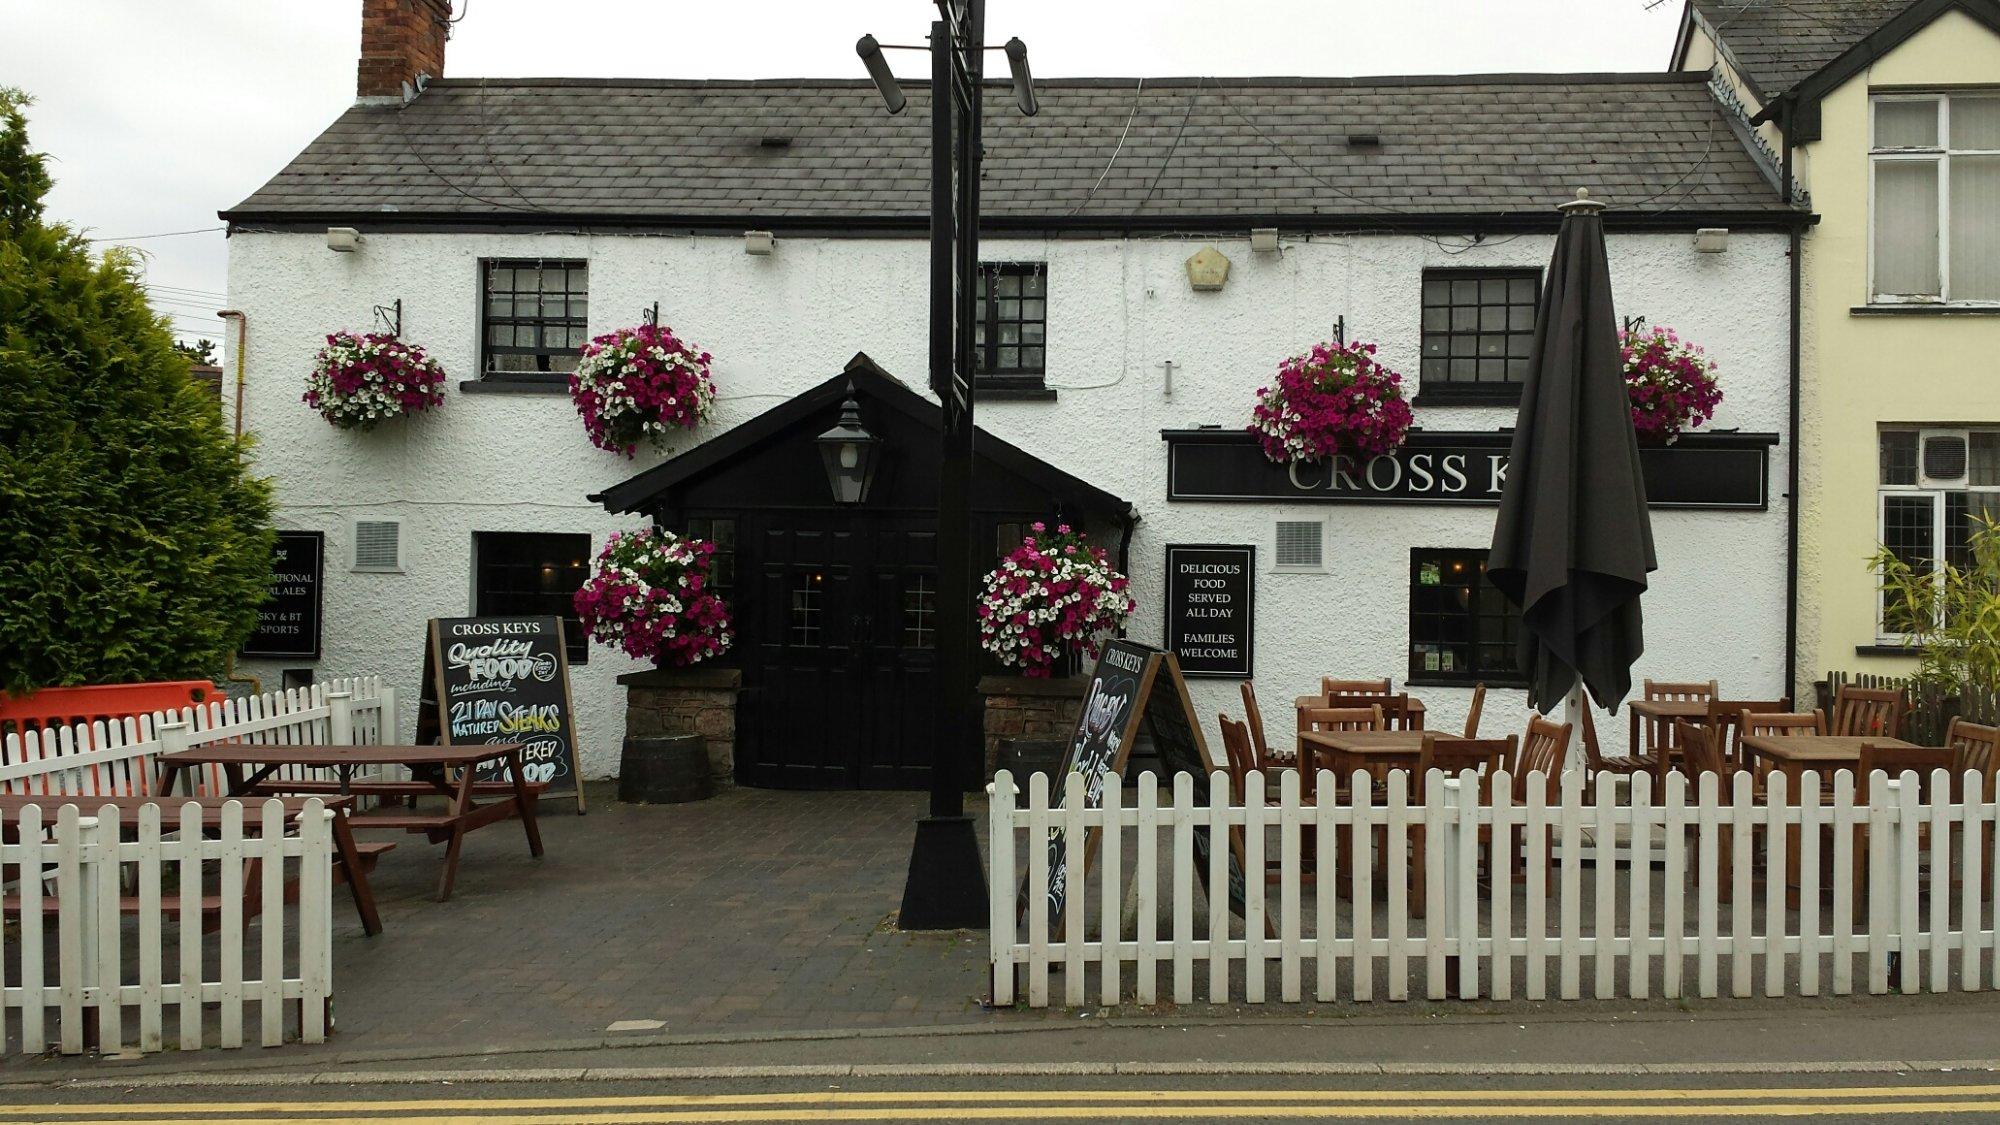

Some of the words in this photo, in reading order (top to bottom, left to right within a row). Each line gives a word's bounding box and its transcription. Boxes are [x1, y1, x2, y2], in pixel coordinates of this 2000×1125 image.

[1289, 454, 1467, 492] CROSS
[1180, 564, 1240, 574] DELICIOUS
[1194, 579, 1226, 588] FOOD
[282, 587, 307, 596] ALES
[1188, 593, 1231, 603] SERVED
[258, 613, 277, 621] SKY
[280, 613, 287, 621] &
[289, 613, 302, 621] BT
[1186, 608, 1207, 617] ALL
[1210, 608, 1233, 618] DAY
[260, 625, 299, 634] SPORTS
[452, 623, 500, 635] CROSS
[503, 622, 541, 634] KEYS
[1184, 634, 1235, 643] FAMILIES
[448, 638, 533, 664] Quality
[1180, 648, 1238, 658] WELCOME
[1105, 648, 1125, 668] CROSS
[1122, 652, 1143, 674] KEYS
[469, 658, 533, 681] FOOD
[451, 680, 512, 692] including
[451, 701, 472, 722] 21
[475, 699, 498, 720] DAY
[498, 701, 560, 734] STEAKS
[452, 720, 500, 737] MATURED
